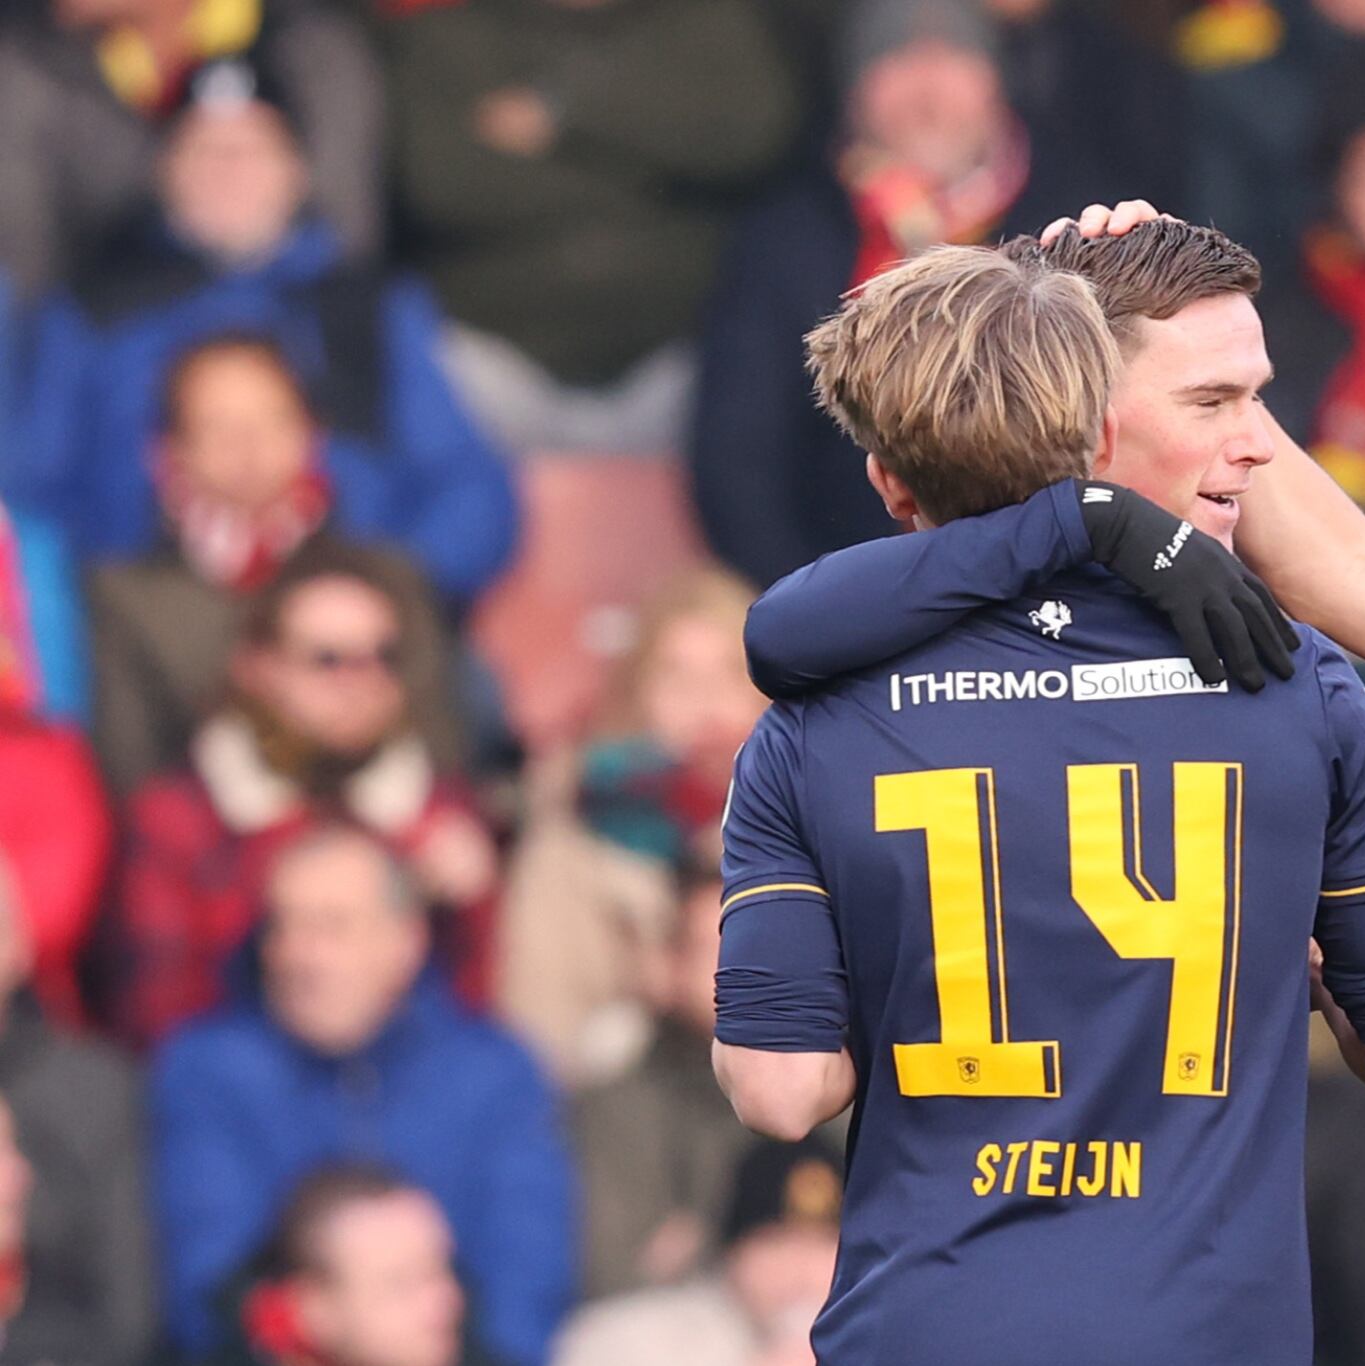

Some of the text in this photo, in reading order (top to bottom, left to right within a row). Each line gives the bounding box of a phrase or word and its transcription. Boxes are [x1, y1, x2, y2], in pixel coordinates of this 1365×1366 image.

[1079, 664, 1221, 697] Solution
[874, 762, 1243, 1098] 14
[972, 1140, 1142, 1198] STEIJN
